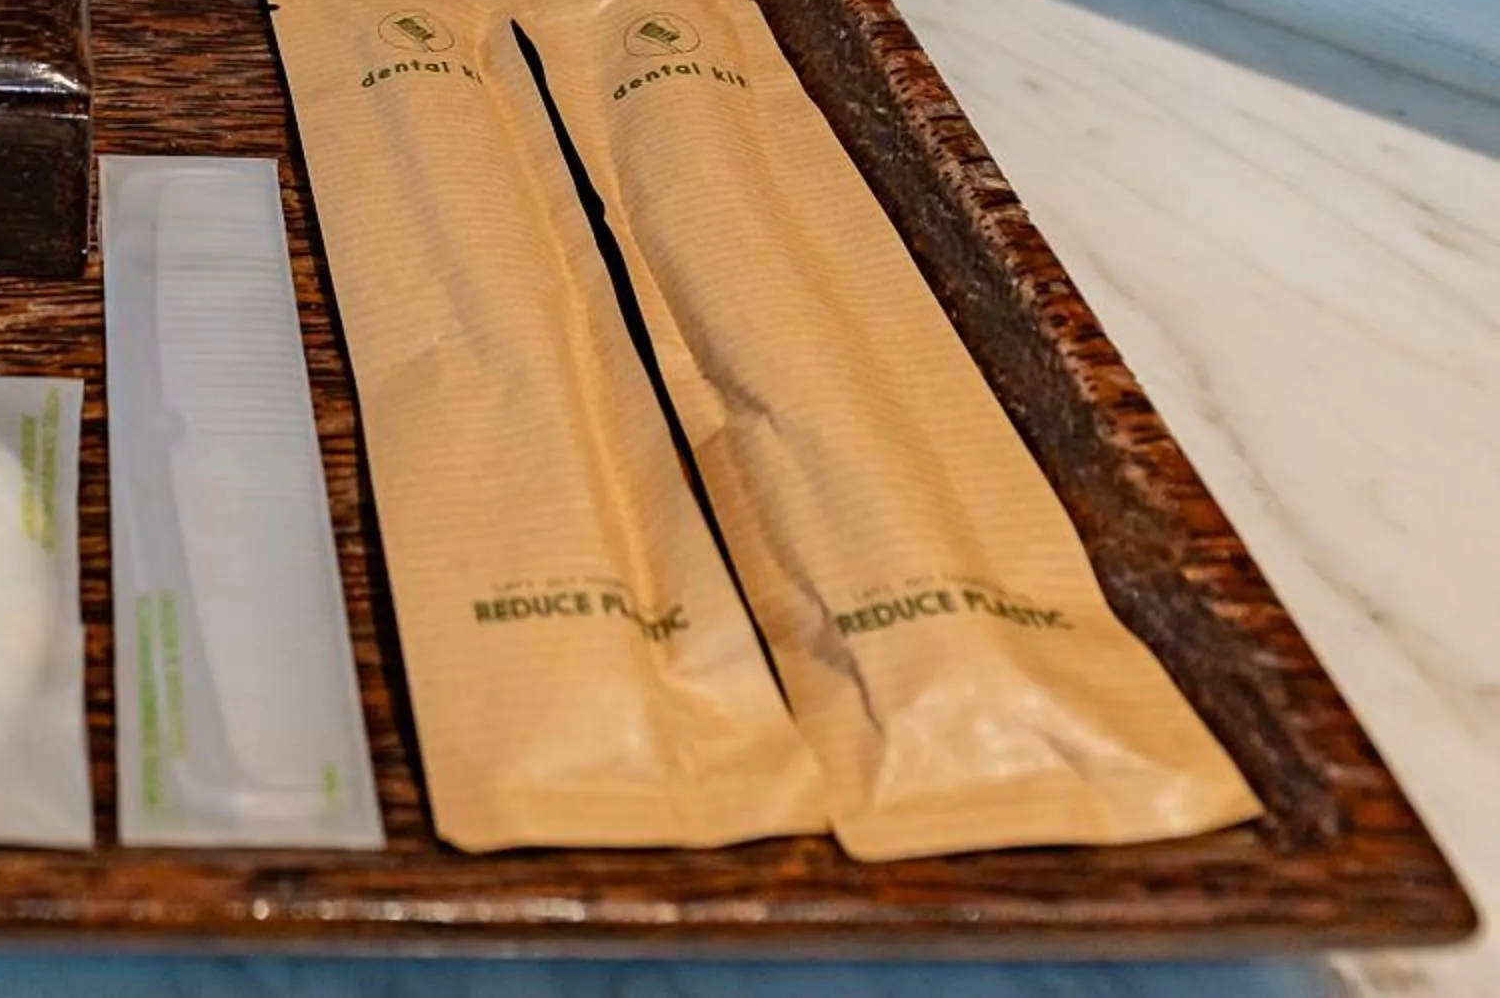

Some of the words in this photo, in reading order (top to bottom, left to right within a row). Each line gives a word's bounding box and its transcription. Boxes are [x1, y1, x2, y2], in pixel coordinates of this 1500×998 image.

[362, 59, 450, 88] dental
[461, 64, 484, 86] ki
[613, 62, 701, 100] dental
[711, 66, 746, 89] kit
[473, 592, 593, 625] REDUCE
[836, 590, 958, 637] REDUCE
[961, 589, 1076, 631] PLASTIC
